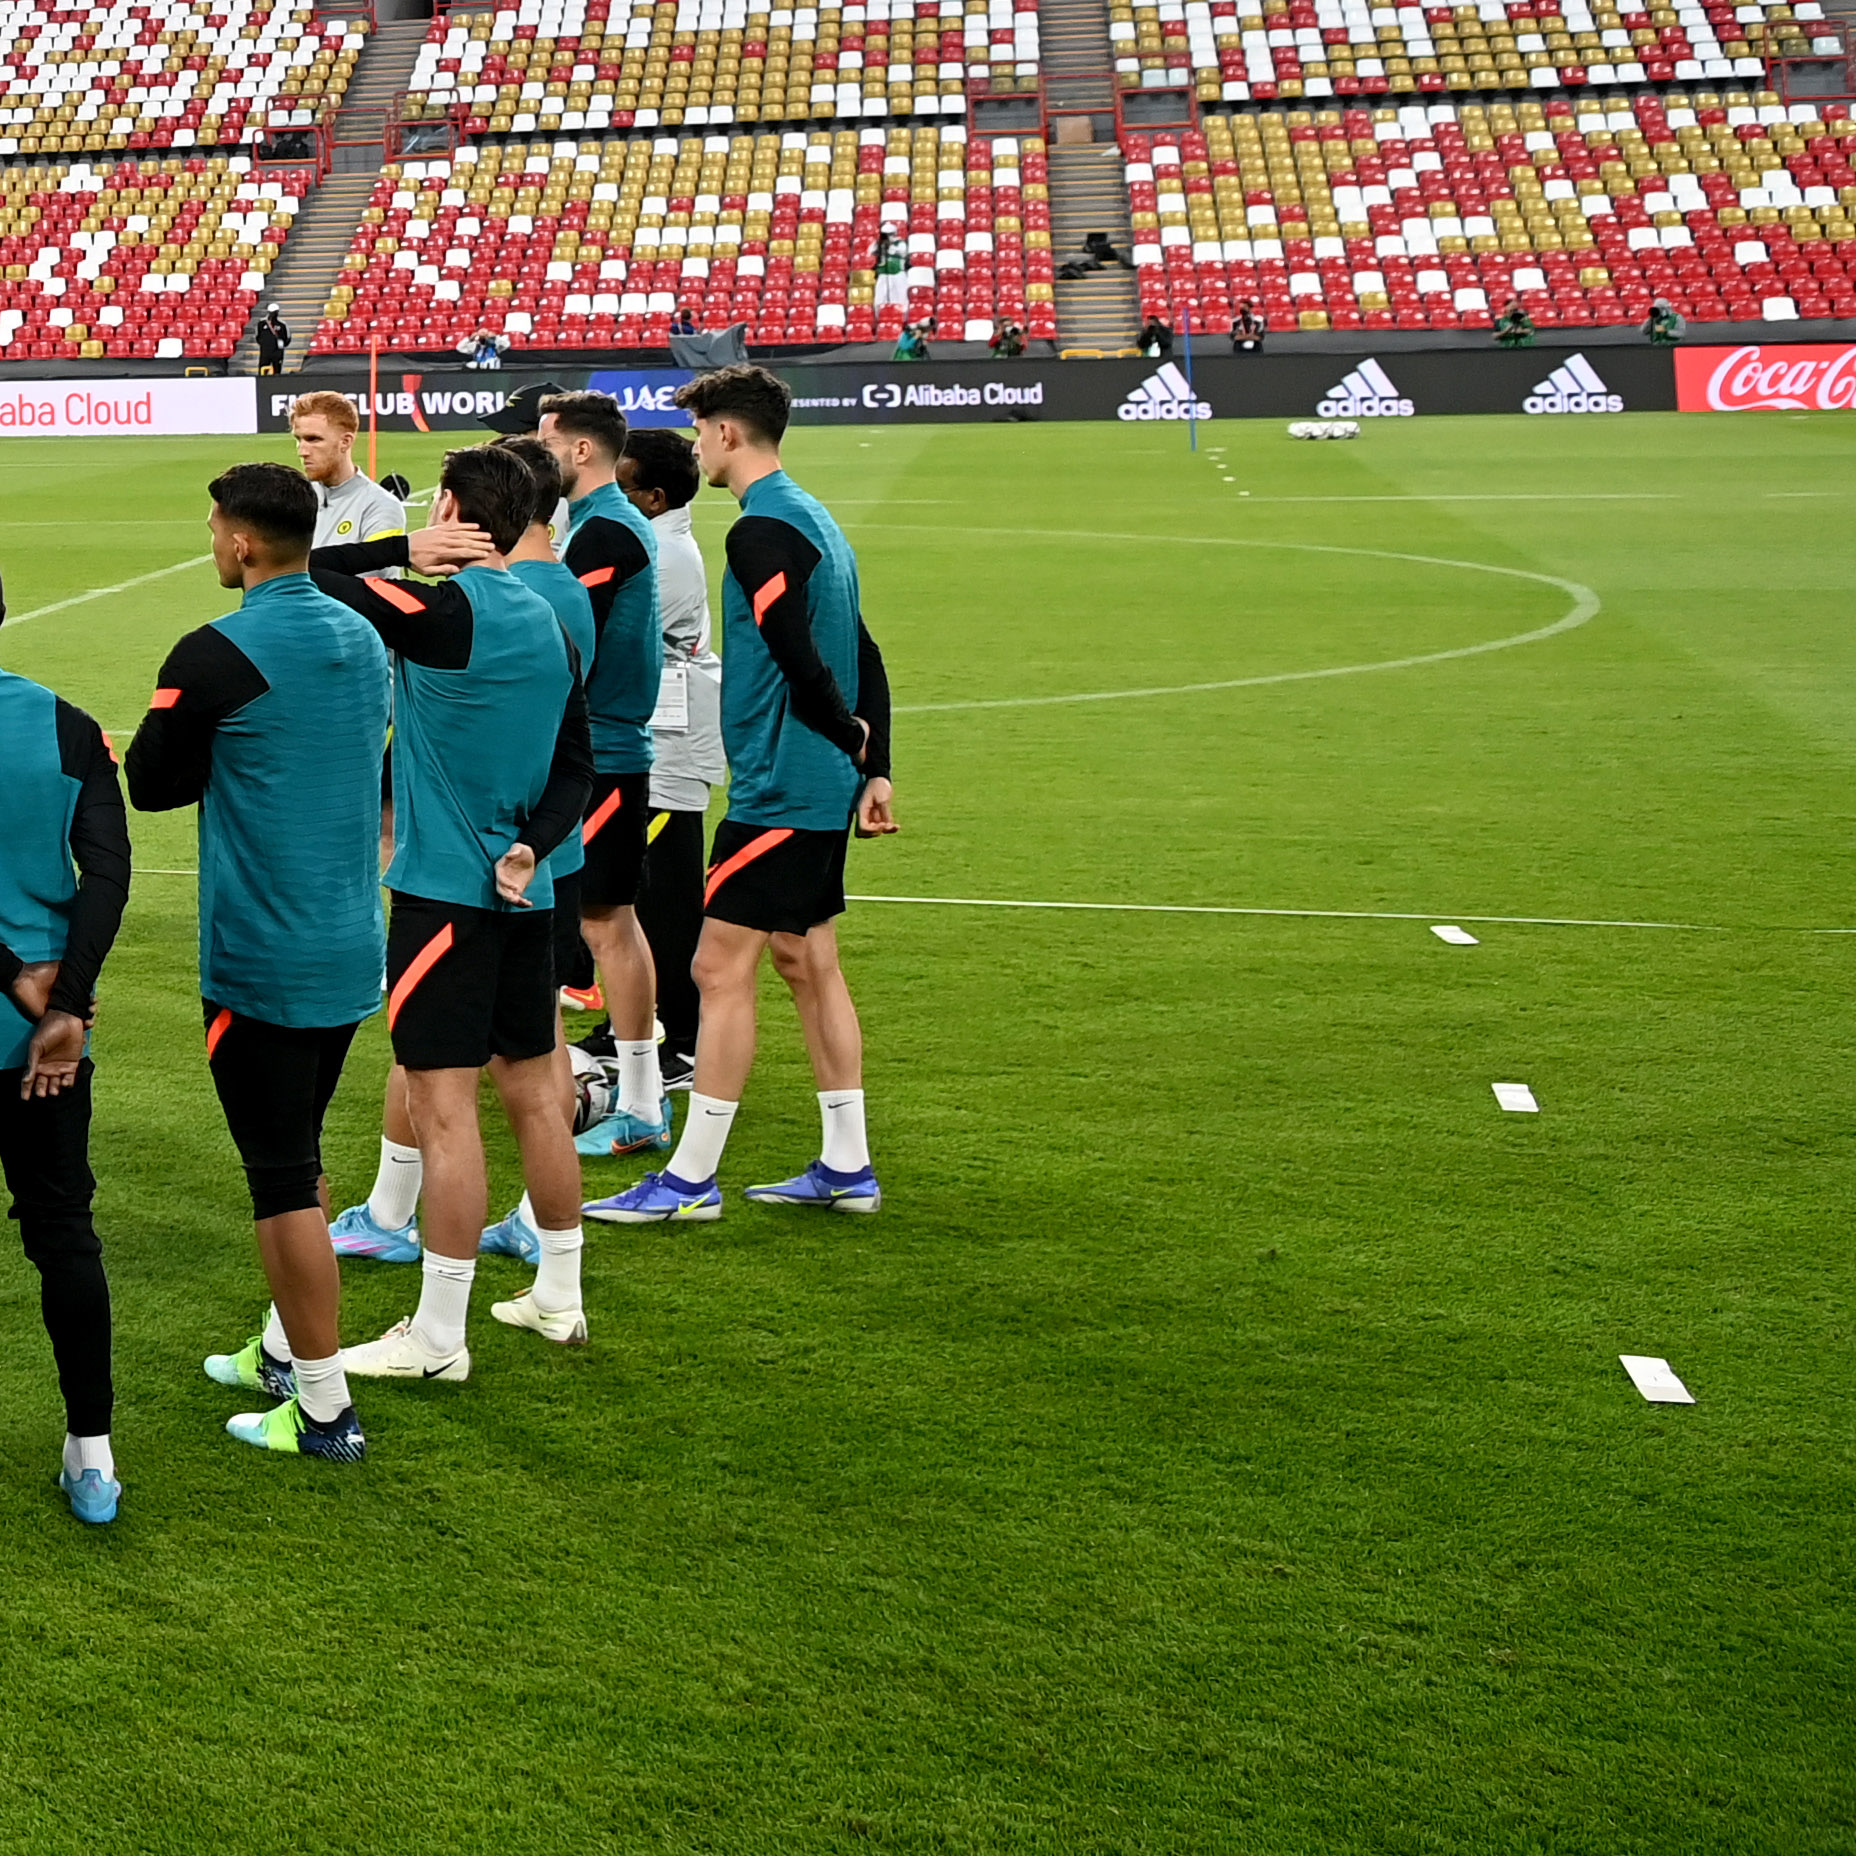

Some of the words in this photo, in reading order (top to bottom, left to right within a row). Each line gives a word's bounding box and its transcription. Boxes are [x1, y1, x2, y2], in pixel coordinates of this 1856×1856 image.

[842, 397, 857, 407] BY
[904, 381, 980, 407] Alibaba
[984, 381, 1044, 405] Cloud
[1521, 392, 1623, 415] adidas
[64, 390, 154, 425] Cloud
[1117, 400, 1212, 421] adidas
[1316, 396, 1414, 417] adidas
